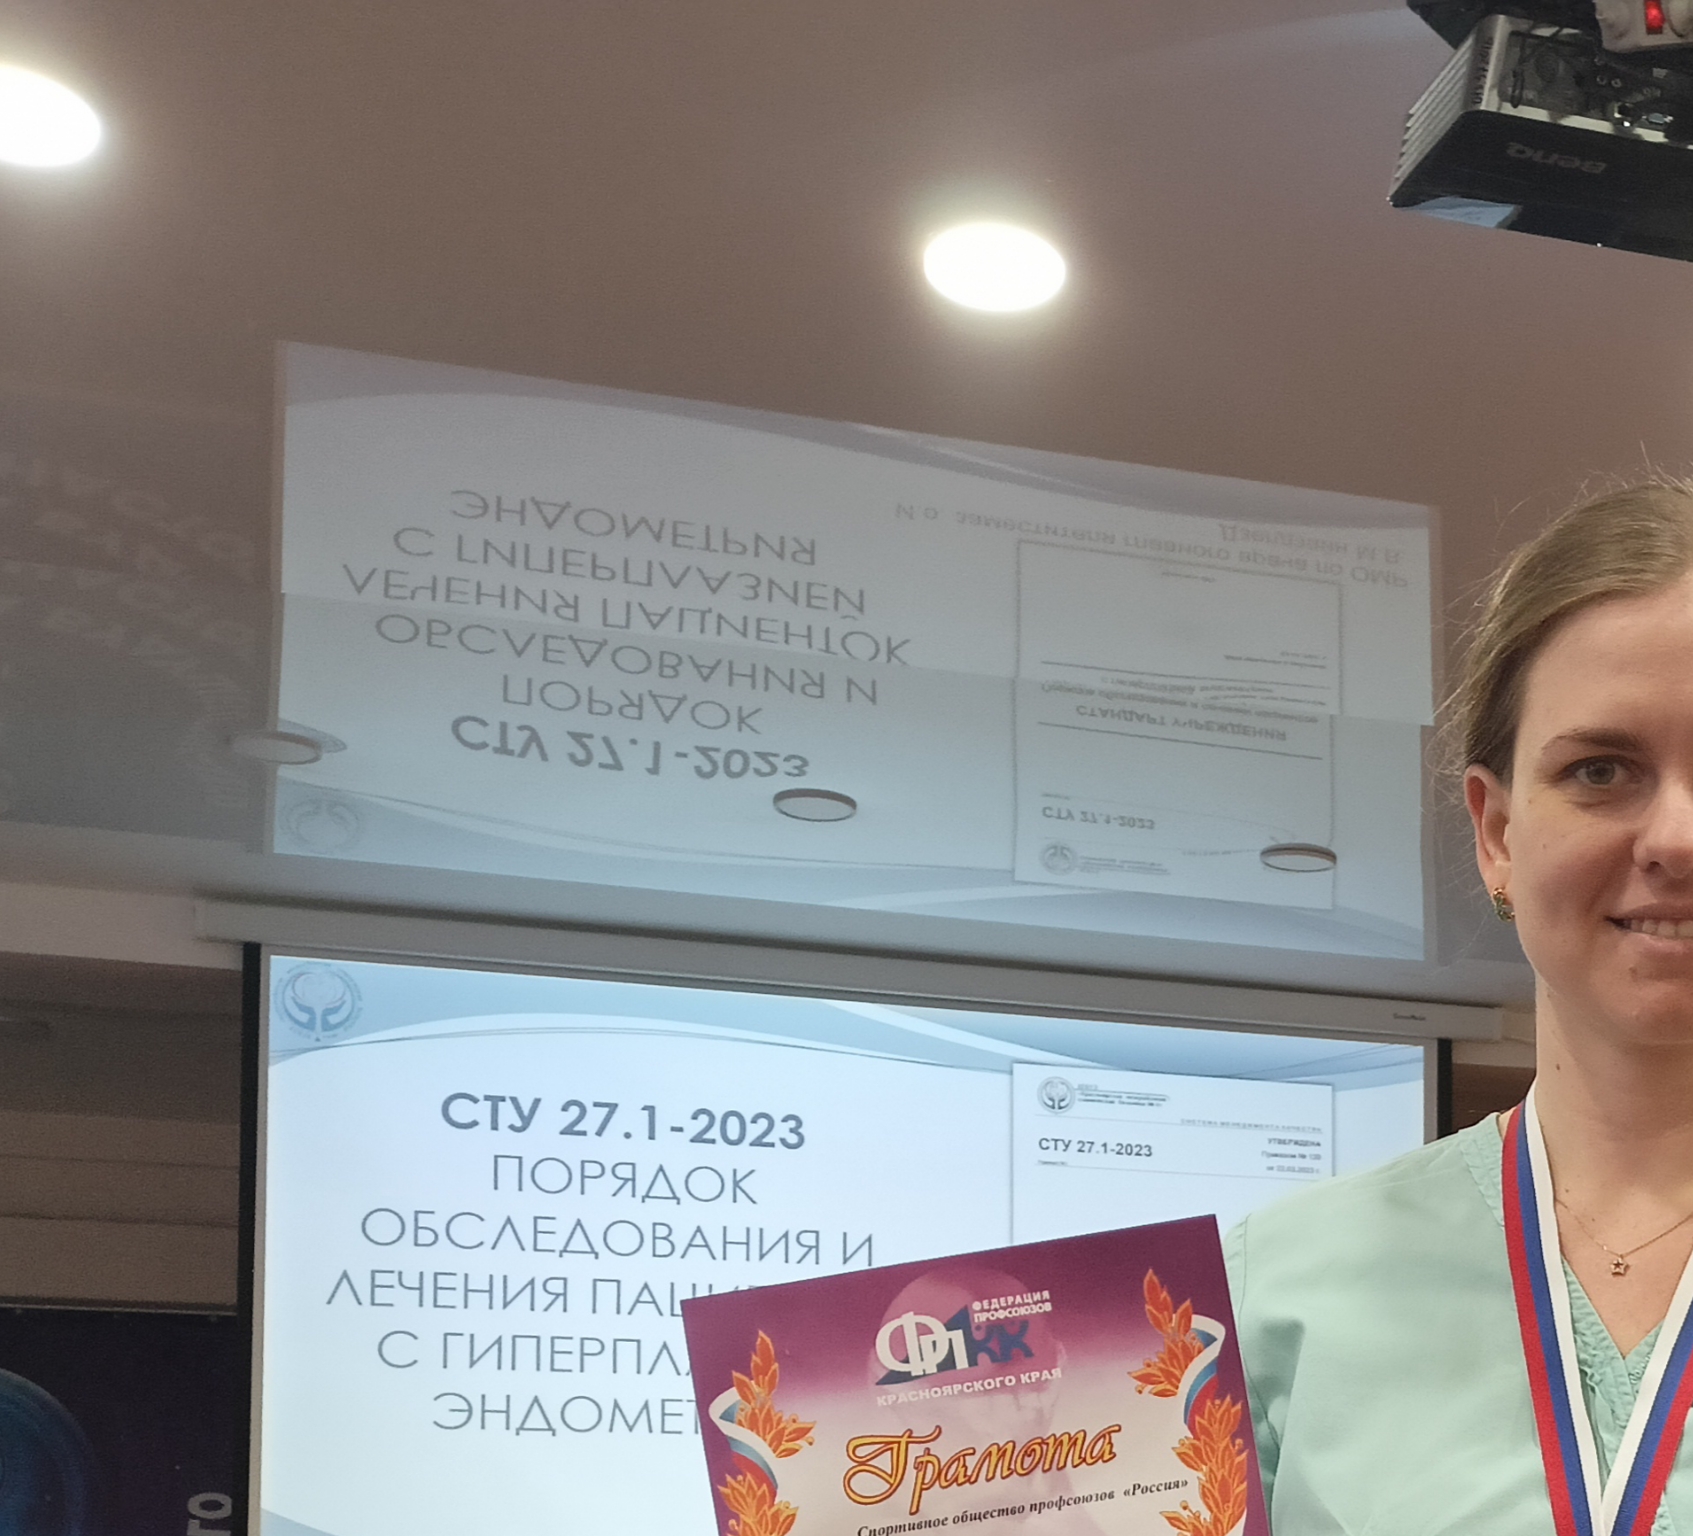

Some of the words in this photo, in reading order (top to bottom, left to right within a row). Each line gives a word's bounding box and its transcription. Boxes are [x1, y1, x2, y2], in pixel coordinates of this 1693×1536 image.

[438, 1090, 543, 1137] СТУ
[558, 1098, 807, 1152] 27.1-2023
[1038, 1137, 1072, 1153] СТУ
[1076, 1139, 1154, 1158] 27.1-2023
[491, 1154, 759, 1206] ПОРЯДОК
[360, 1207, 823, 1266] ОБСЛЕДОВАНИЯ
[841, 1232, 875, 1268] И
[325, 1268, 569, 1313] ЛЕЧЕНИЯ
[971, 1290, 1051, 1312] ФЕДЕРАЦИЯ
[973, 1302, 1053, 1323] ПРОФСОЮЗОВ
[377, 1330, 420, 1370] С
[441, 1332, 691, 1377] ГИПЕРПЛ
[875, 1374, 1017, 1407] КРАСНОЯРСКОГО
[1019, 1366, 1063, 1386] КРАЯ
[842, 1424, 1122, 1516] Грамота
[951, 1502, 1026, 1528] общество
[1028, 1488, 1116, 1514] профсоюзов
[1122, 1477, 1190, 1499] «Россия»
